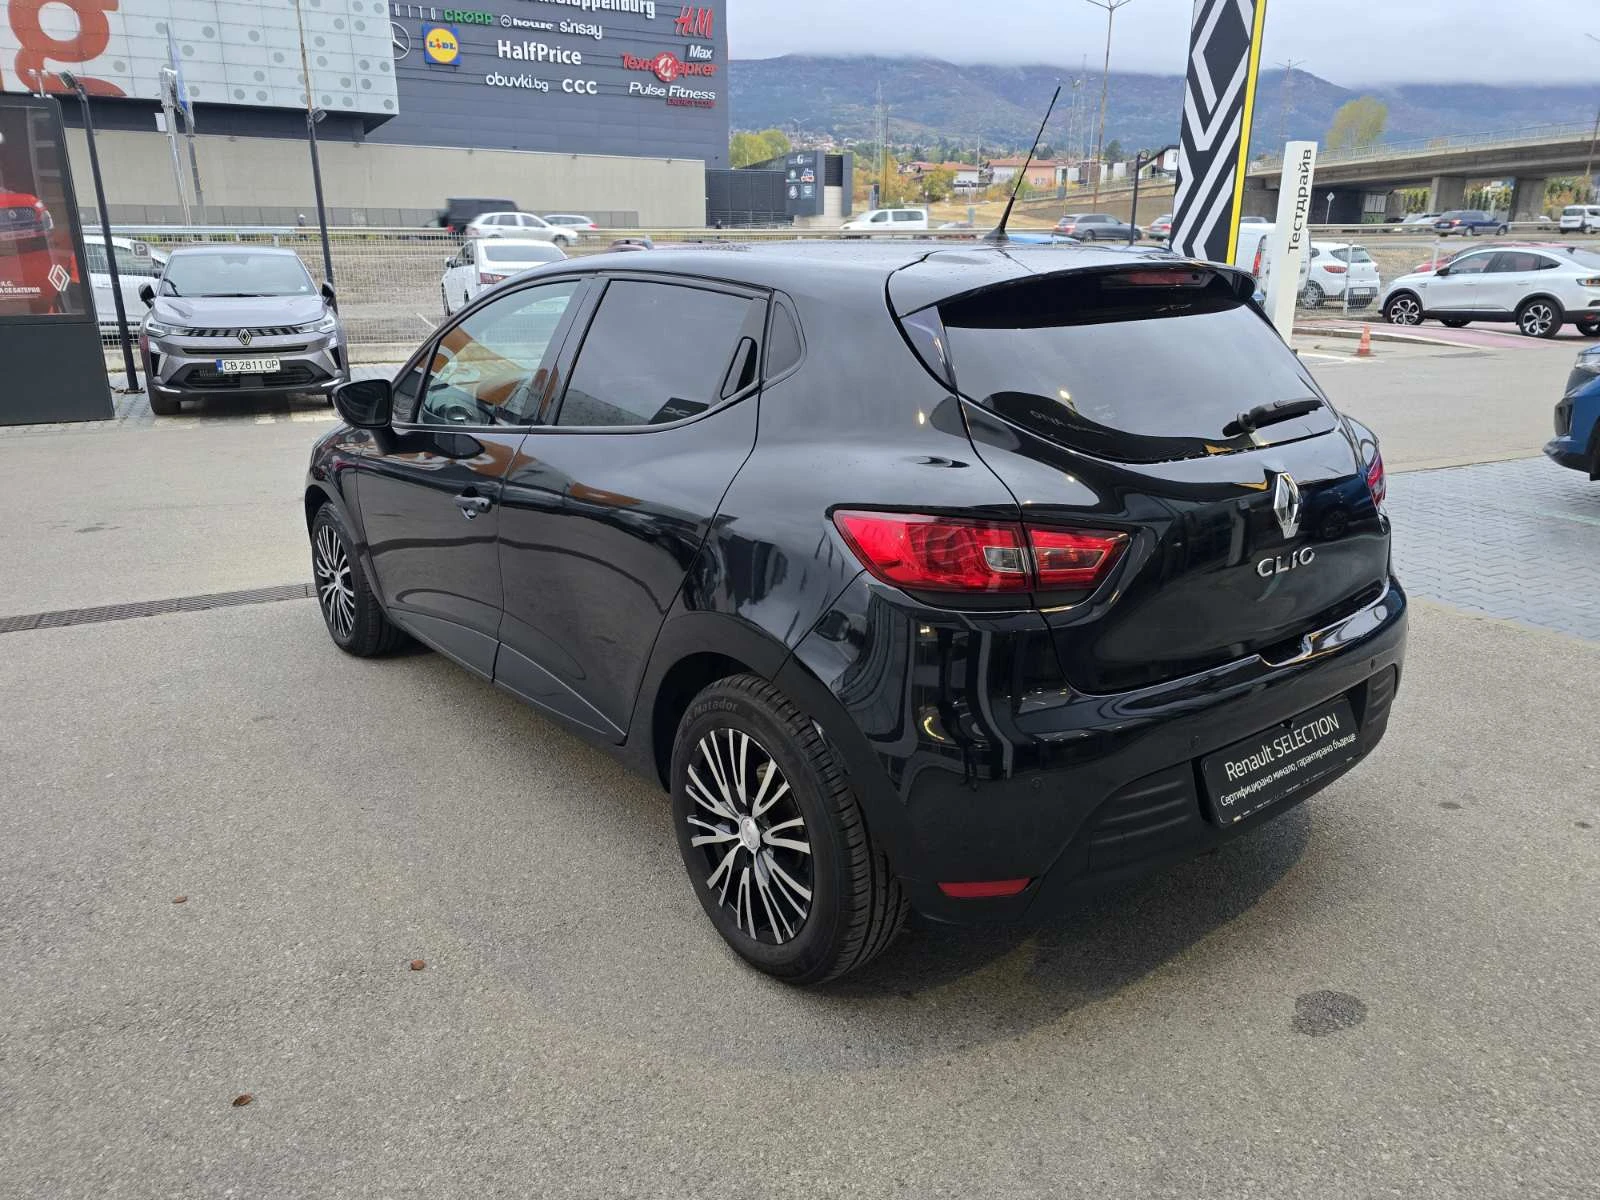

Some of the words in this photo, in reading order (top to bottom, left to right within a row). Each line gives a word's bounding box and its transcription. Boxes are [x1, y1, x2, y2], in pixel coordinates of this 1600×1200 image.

[443, 9, 494, 25] CROPP
[559, 18, 603, 40] sinsay
[497, 39, 582, 65] HalfPrice
[689, 45, 713, 59] Max
[485, 72, 549, 92] obuvki.bg
[562, 79, 598, 95] CCC
[629, 81, 666, 96] Pulse
[668, 85, 716, 100] Fitness
[1288, 149, 1312, 254] Тестдрайв
[240, 360, 263, 371] 2811
[1256, 547, 1316, 578] CLIO
[1224, 744, 1275, 782] Renault
[1273, 713, 1340, 759] SELECTION
[1220, 775, 1273, 807] Сертифицирано
[1273, 762, 1298, 780] минало,
[1297, 744, 1334, 769] гарантирано
[1332, 732, 1356, 751] бъдеще
